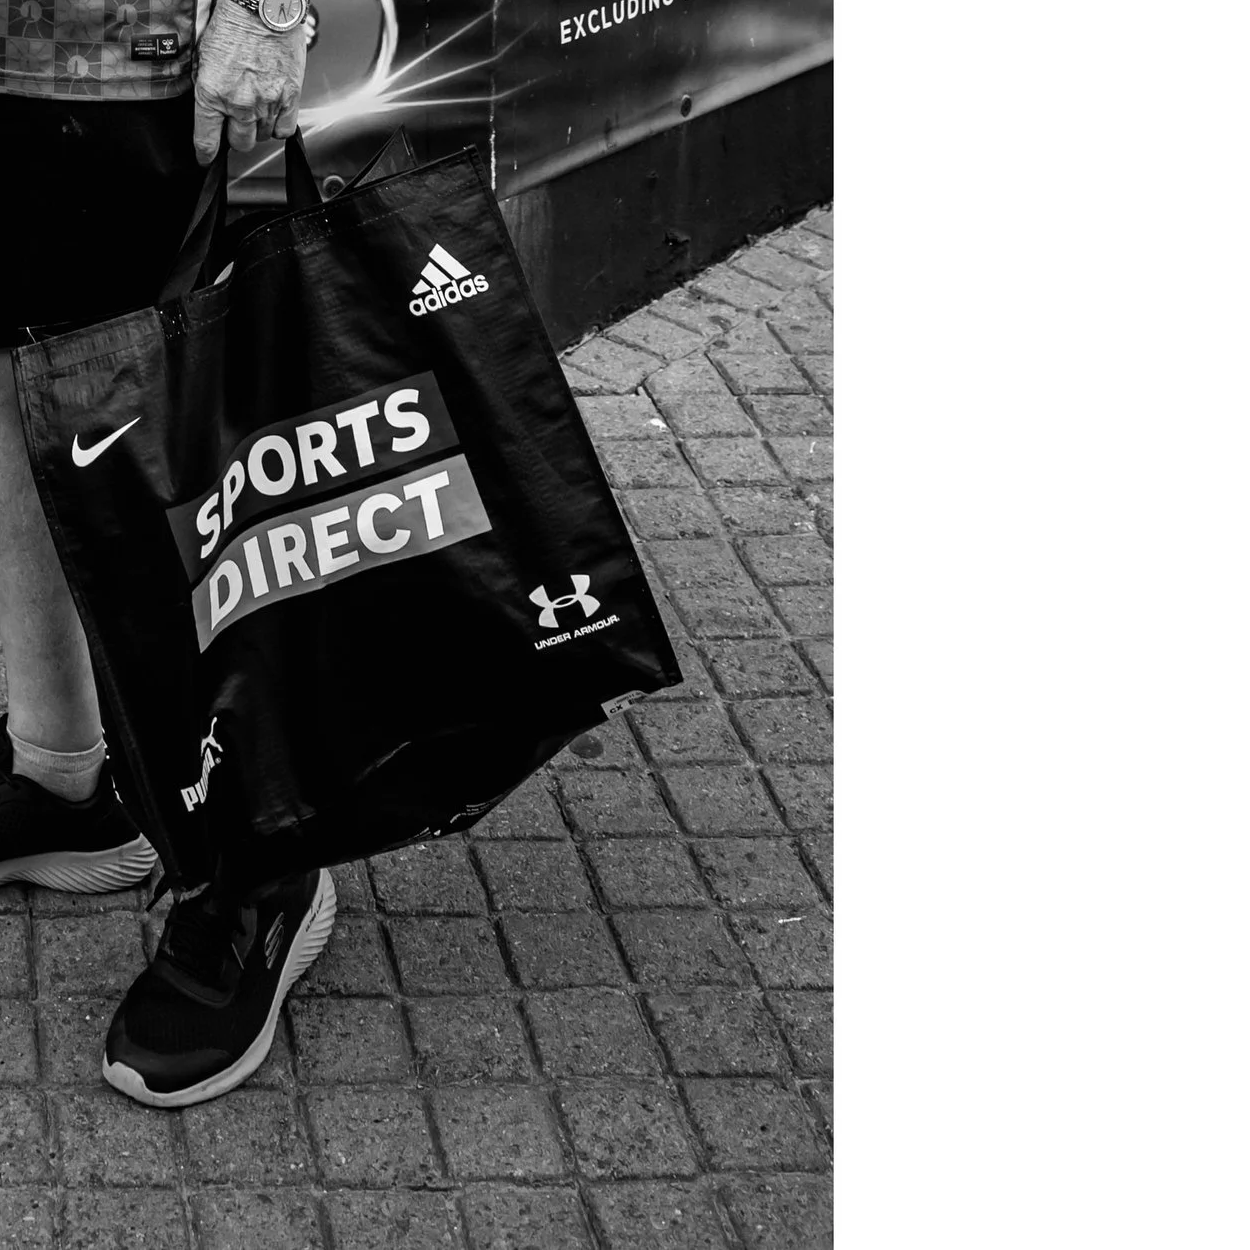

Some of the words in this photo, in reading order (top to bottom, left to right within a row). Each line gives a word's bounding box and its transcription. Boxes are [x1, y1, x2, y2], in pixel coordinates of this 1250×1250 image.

[409, 274, 489, 317] adidas
[196, 388, 431, 559] SPORTS
[208, 470, 450, 631] DIRECT
[534, 632, 572, 650] UNDER
[573, 614, 619, 638] ARMOUR
